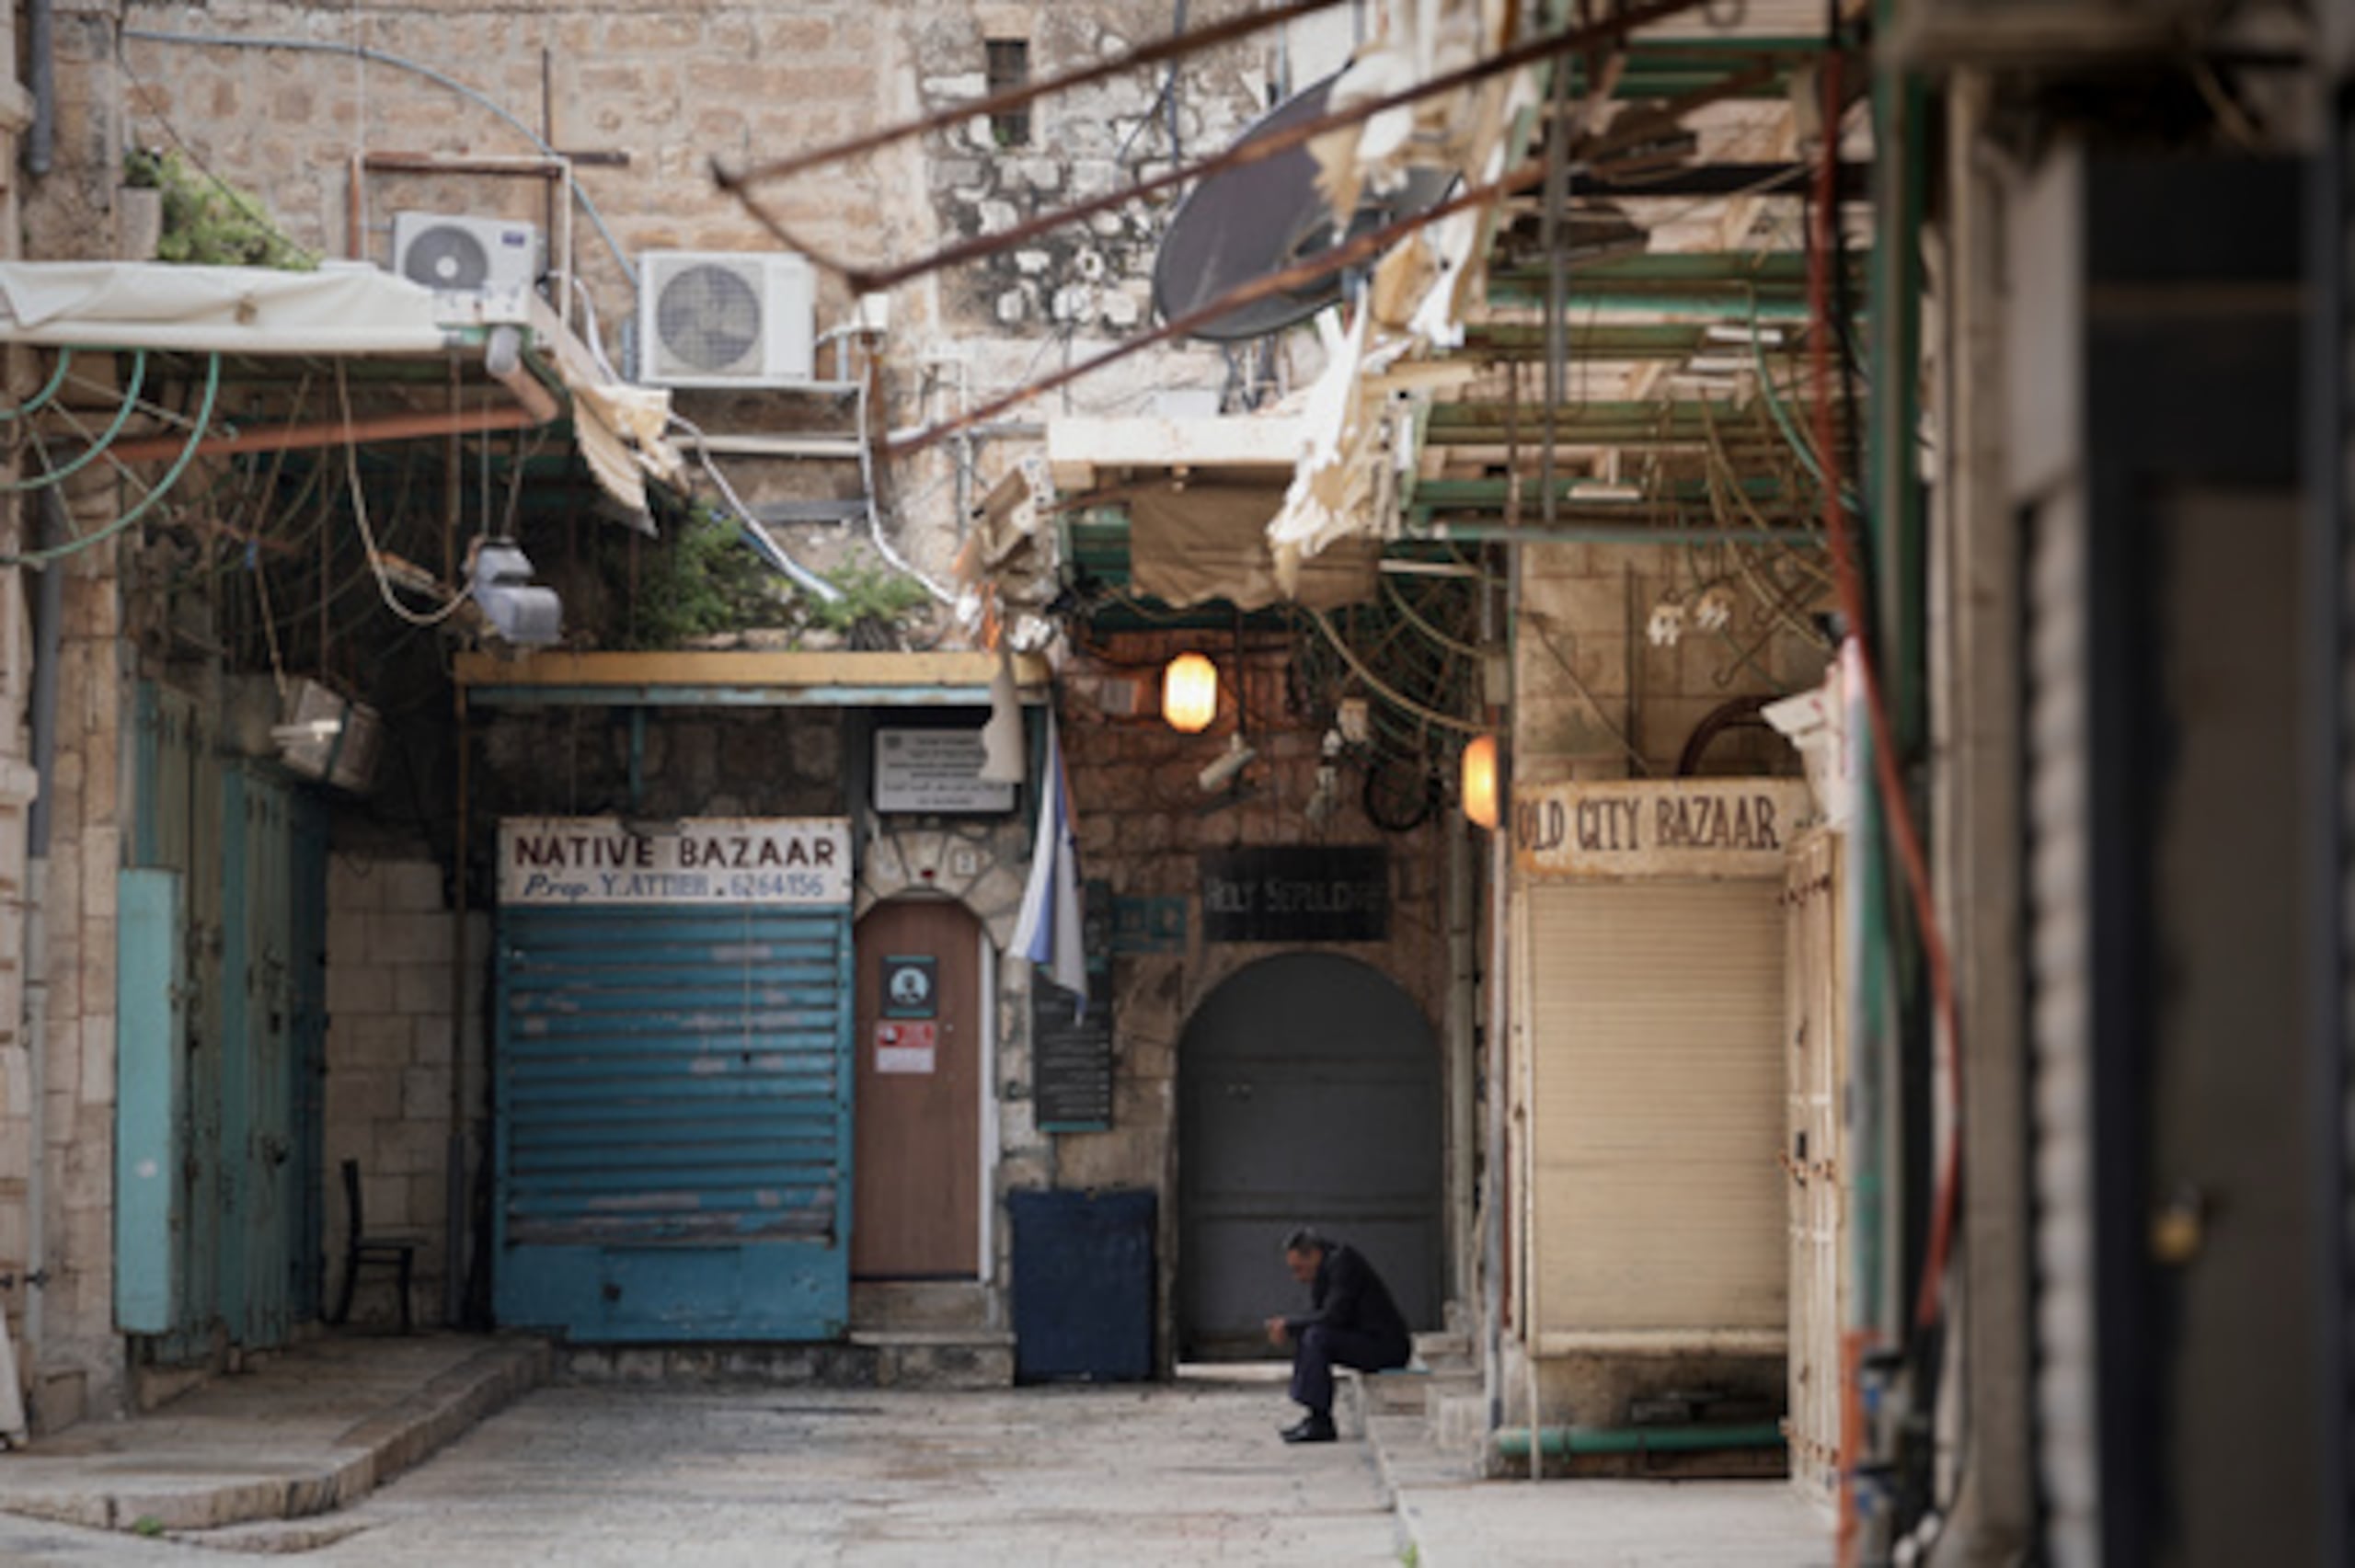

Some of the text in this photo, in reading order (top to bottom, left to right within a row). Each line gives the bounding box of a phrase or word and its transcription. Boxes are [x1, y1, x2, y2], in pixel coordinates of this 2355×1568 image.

[1516, 795, 1780, 851] OLD CITY BAZAAR
[514, 835, 836, 866] NATIVE BAZAAR
